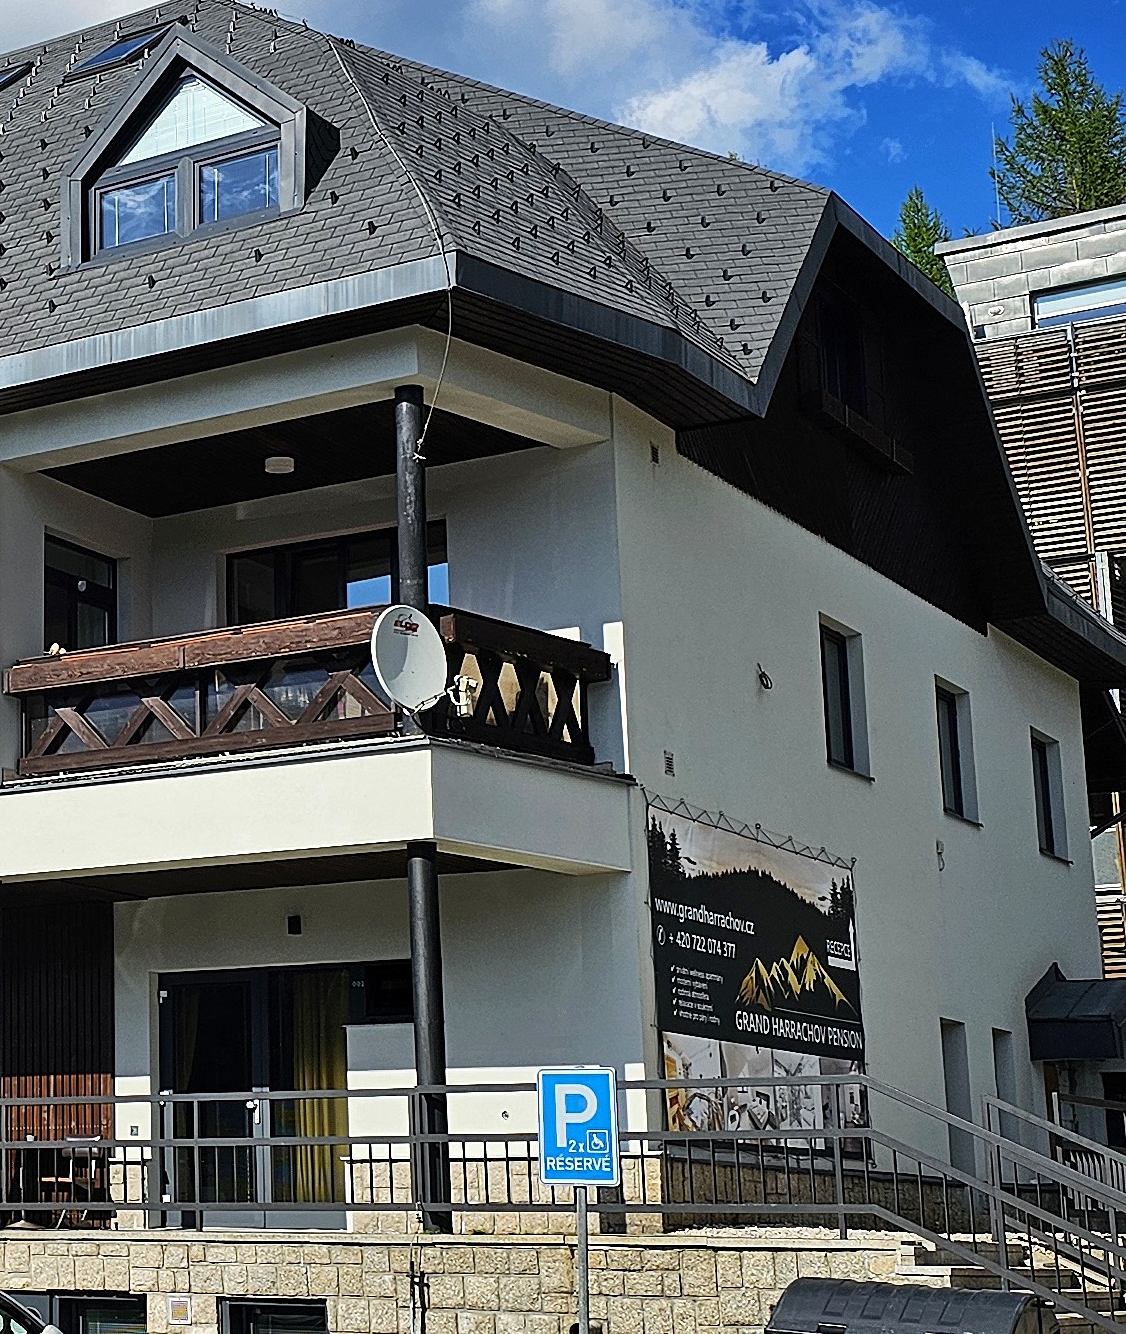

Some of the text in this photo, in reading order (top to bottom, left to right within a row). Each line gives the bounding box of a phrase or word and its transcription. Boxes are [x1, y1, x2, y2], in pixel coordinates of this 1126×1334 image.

[654, 897, 755, 935] www.grandharrachov.cz
[675, 931, 690, 949] 420
[691, 934, 706, 953] 722
[707, 937, 722, 956] 074
[722, 941, 736, 959] 377
[735, 1010, 770, 1035] GRAND
[771, 1016, 826, 1044] HARRACHOV
[828, 1027, 863, 1050] PENSION
[554, 1083, 598, 1148] P
[546, 1153, 612, 1172] RÉSERVÉ
